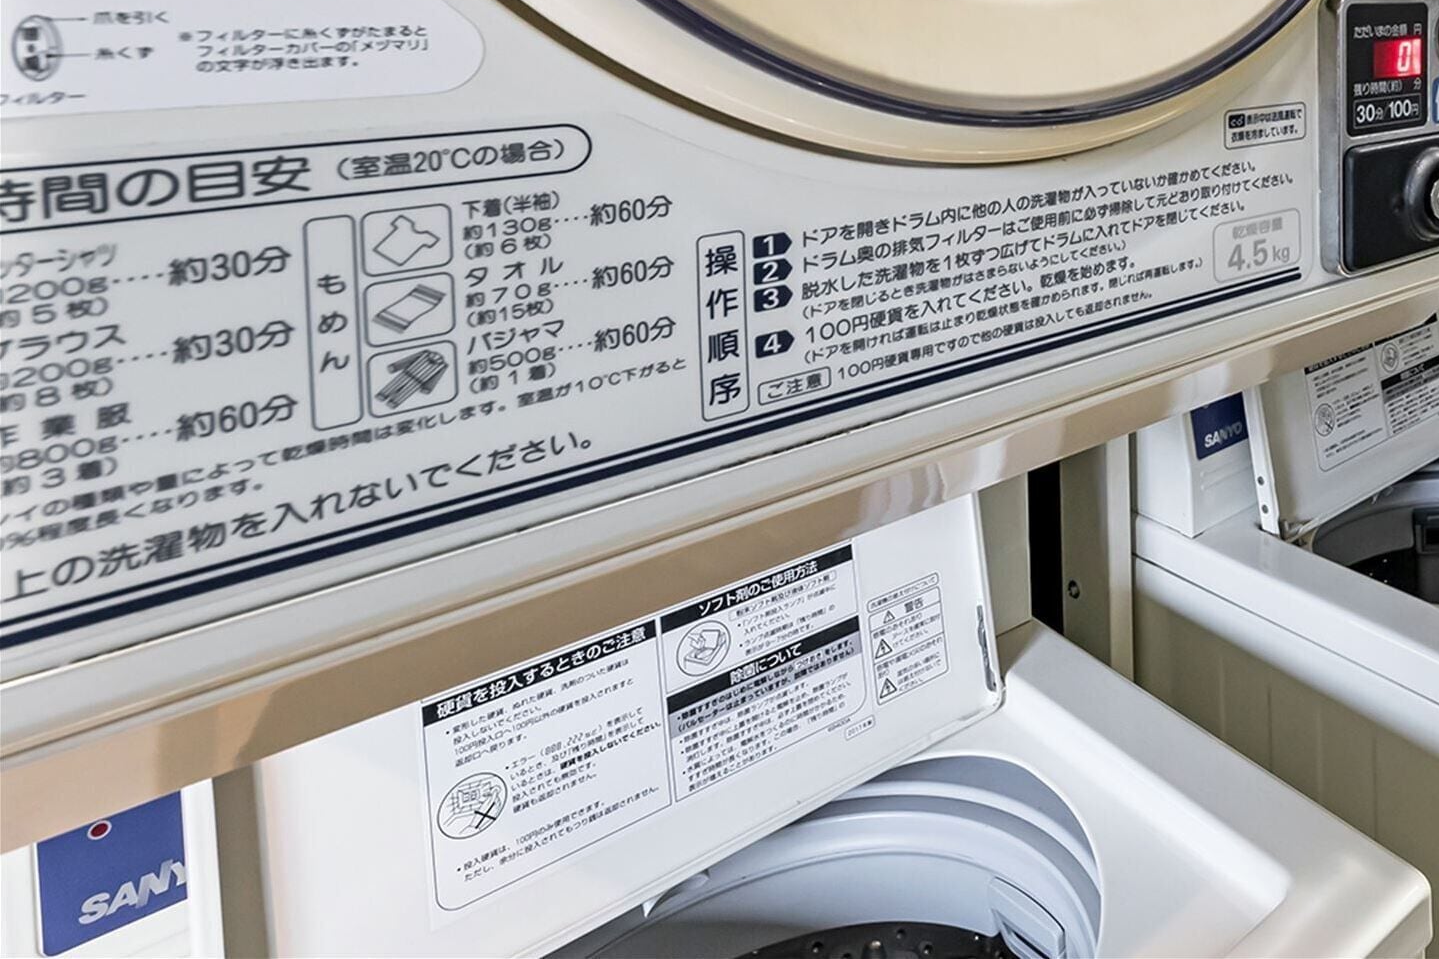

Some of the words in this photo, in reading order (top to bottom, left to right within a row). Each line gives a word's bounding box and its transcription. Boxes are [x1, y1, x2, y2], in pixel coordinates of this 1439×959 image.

[590, 196, 672, 227] 約60分
[168, 246, 291, 288] 約30分
[592, 256, 674, 289] 約60分
[1272, 244, 1290, 263] kg
[172, 322, 296, 364] 約30分
[594, 316, 677, 352] 約60分
[704, 244, 742, 407] 操作順序
[175, 395, 300, 443] 約60分
[1204, 421, 1243, 449] SANYO
[436, 625, 645, 719] 硬貨を投入するときのご注意
